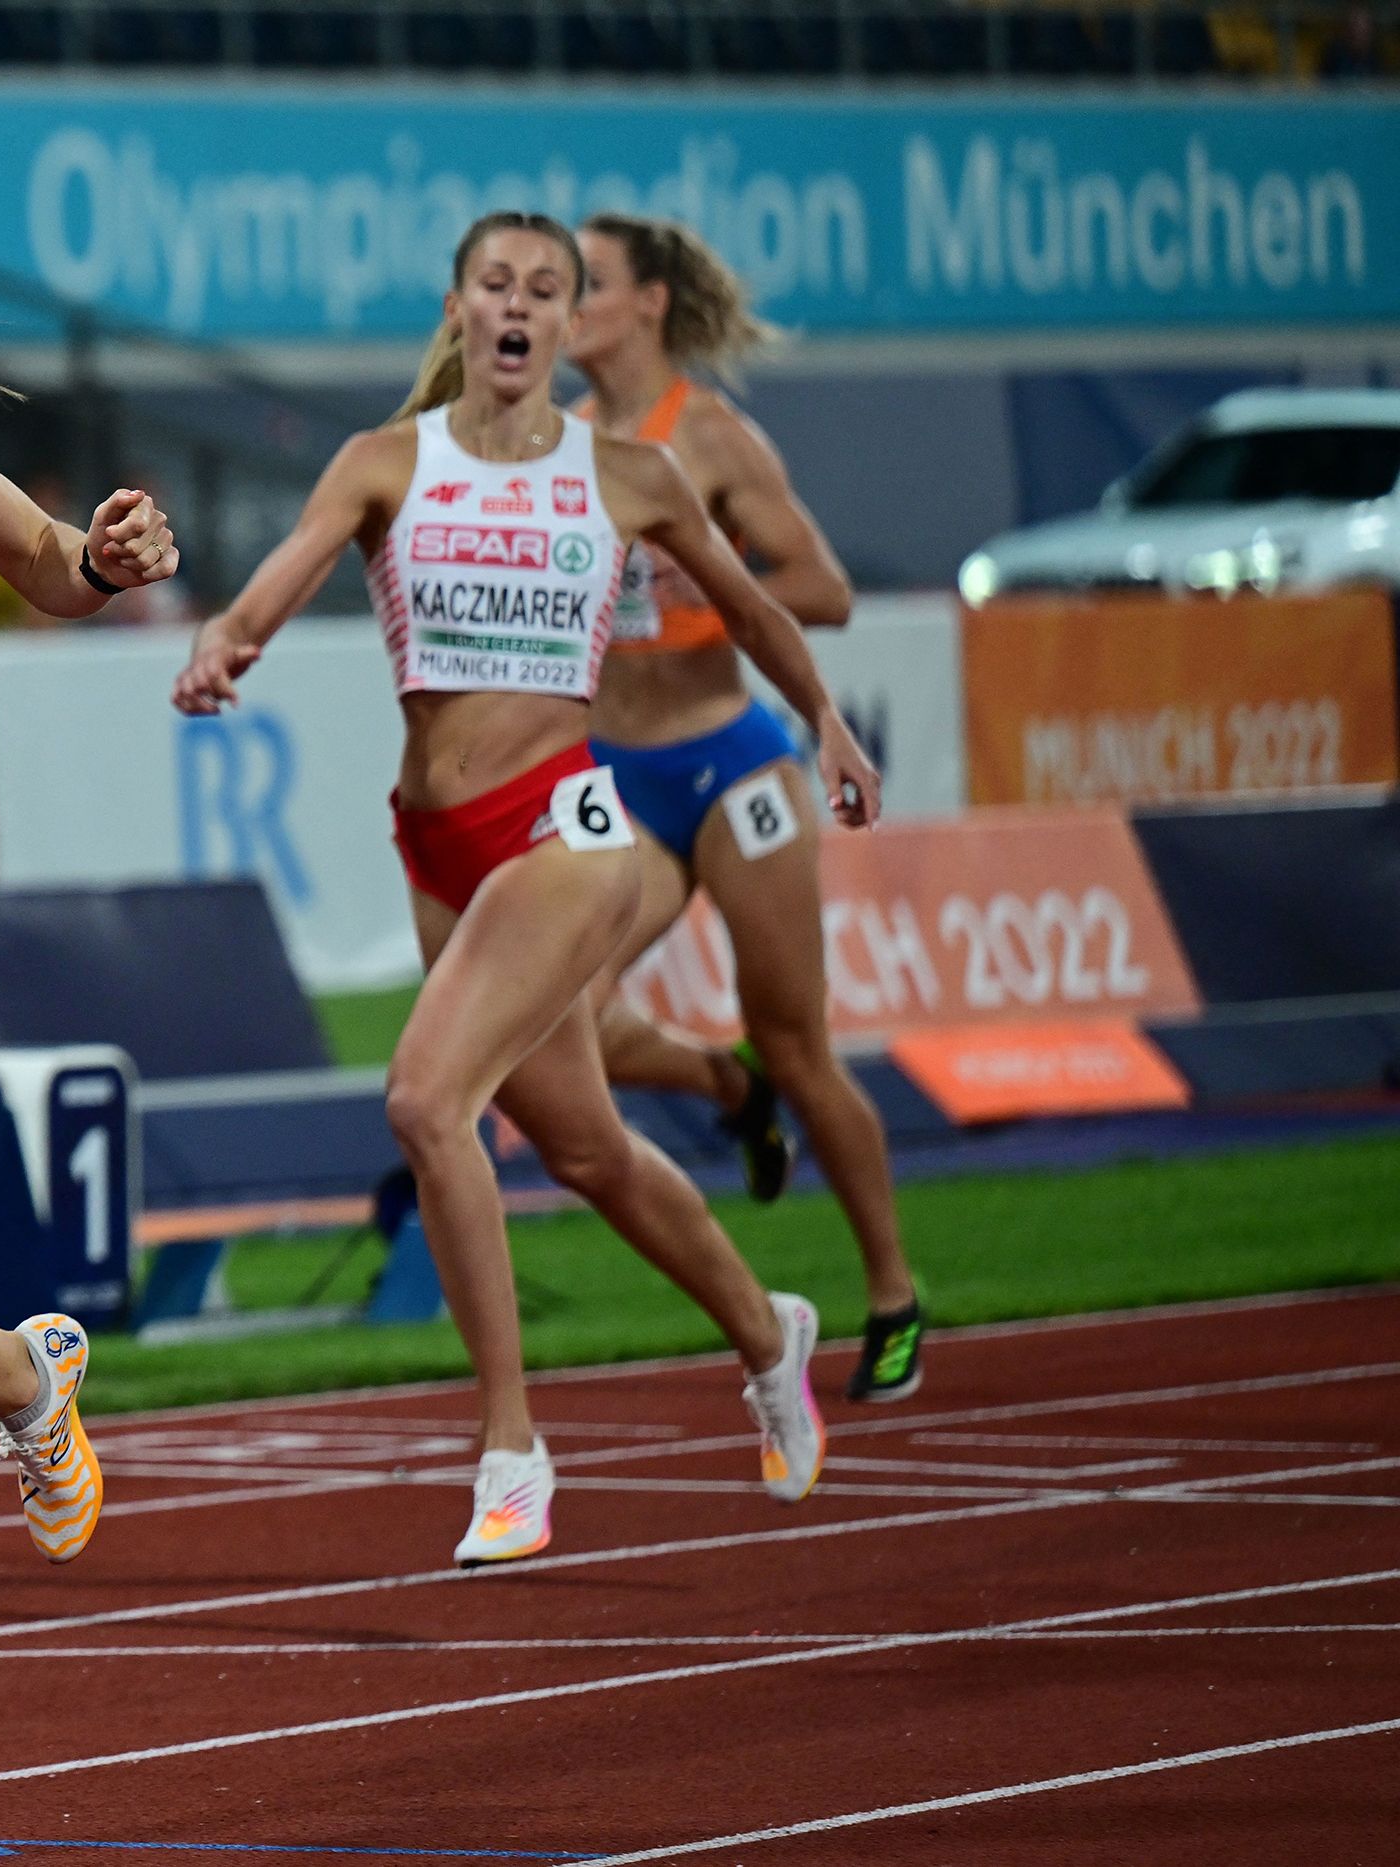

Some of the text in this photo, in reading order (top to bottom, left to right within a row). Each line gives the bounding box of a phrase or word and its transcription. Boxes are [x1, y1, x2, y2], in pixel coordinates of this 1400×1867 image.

[904, 130, 1368, 294] München
[411, 527, 547, 565] SPAR
[410, 578, 590, 634] KACZMAREK
[417, 650, 579, 687] MUNICH 2022
[1022, 696, 1341, 808] MUNICH 2022
[577, 783, 611, 836] 6
[748, 794, 780, 841] 8
[938, 886, 1150, 1010] 2022
[69, 1126, 111, 1265] 1
